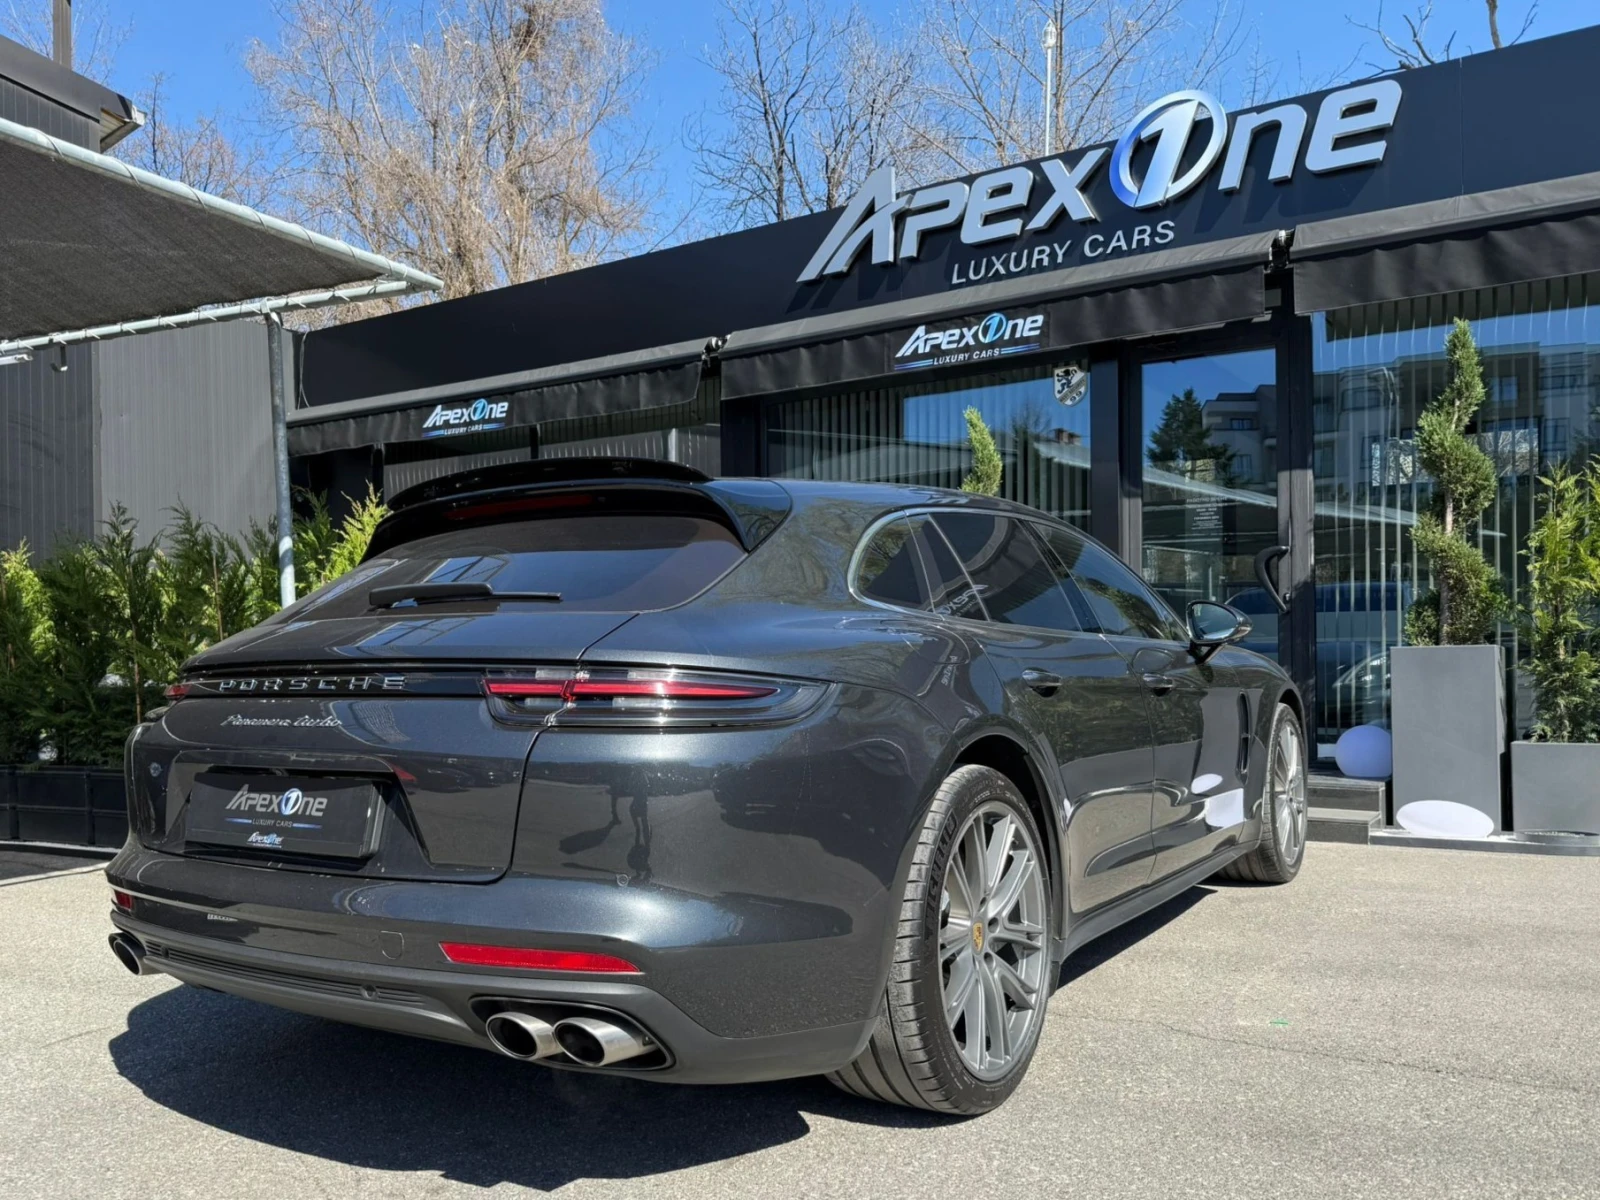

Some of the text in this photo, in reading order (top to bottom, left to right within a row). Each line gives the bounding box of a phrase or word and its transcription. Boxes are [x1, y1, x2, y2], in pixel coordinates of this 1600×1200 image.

[951, 220, 1176, 285] LUXURY CARS
[933, 347, 1000, 365] LUXURY CARS
[444, 423, 484, 436] LUXURY CARS
[219, 676, 406, 692] PORSCHE
[219, 713, 292, 728] Panamera
[252, 818, 293, 829] LUXURY CARS
